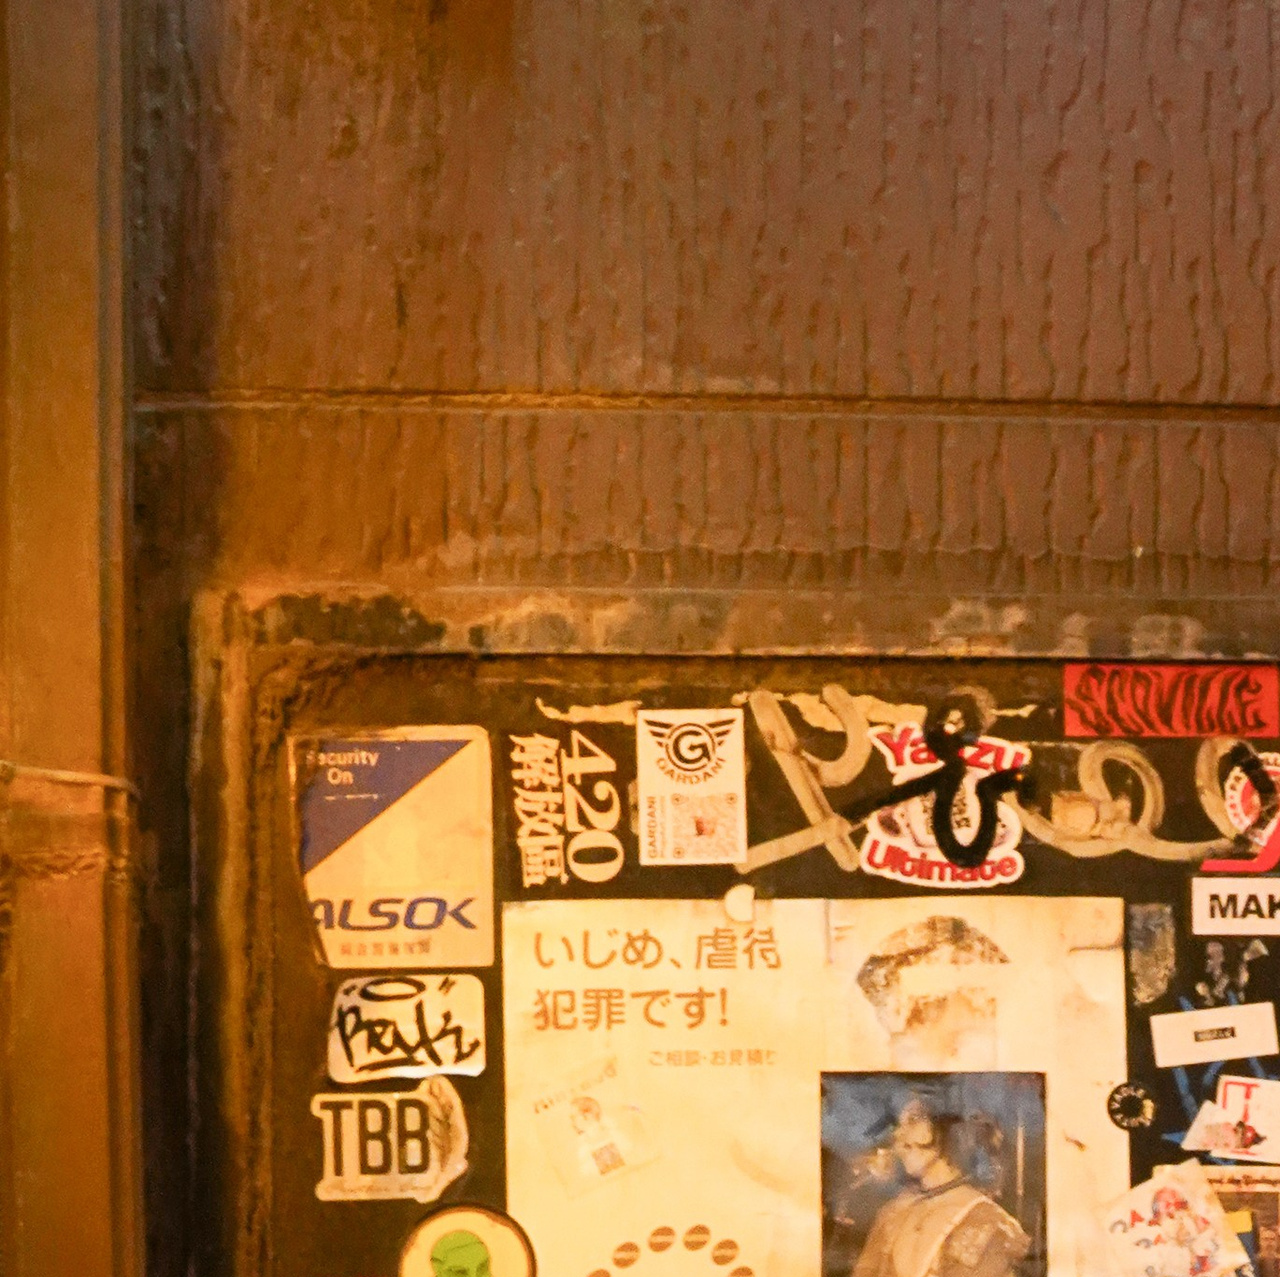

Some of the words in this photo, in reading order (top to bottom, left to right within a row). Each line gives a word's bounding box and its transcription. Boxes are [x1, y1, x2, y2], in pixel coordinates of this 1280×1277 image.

[326, 768, 354, 786] On
[561, 730, 624, 883] 420
[311, 896, 478, 930] ALSOK
[317, 1099, 431, 1178] TBB
